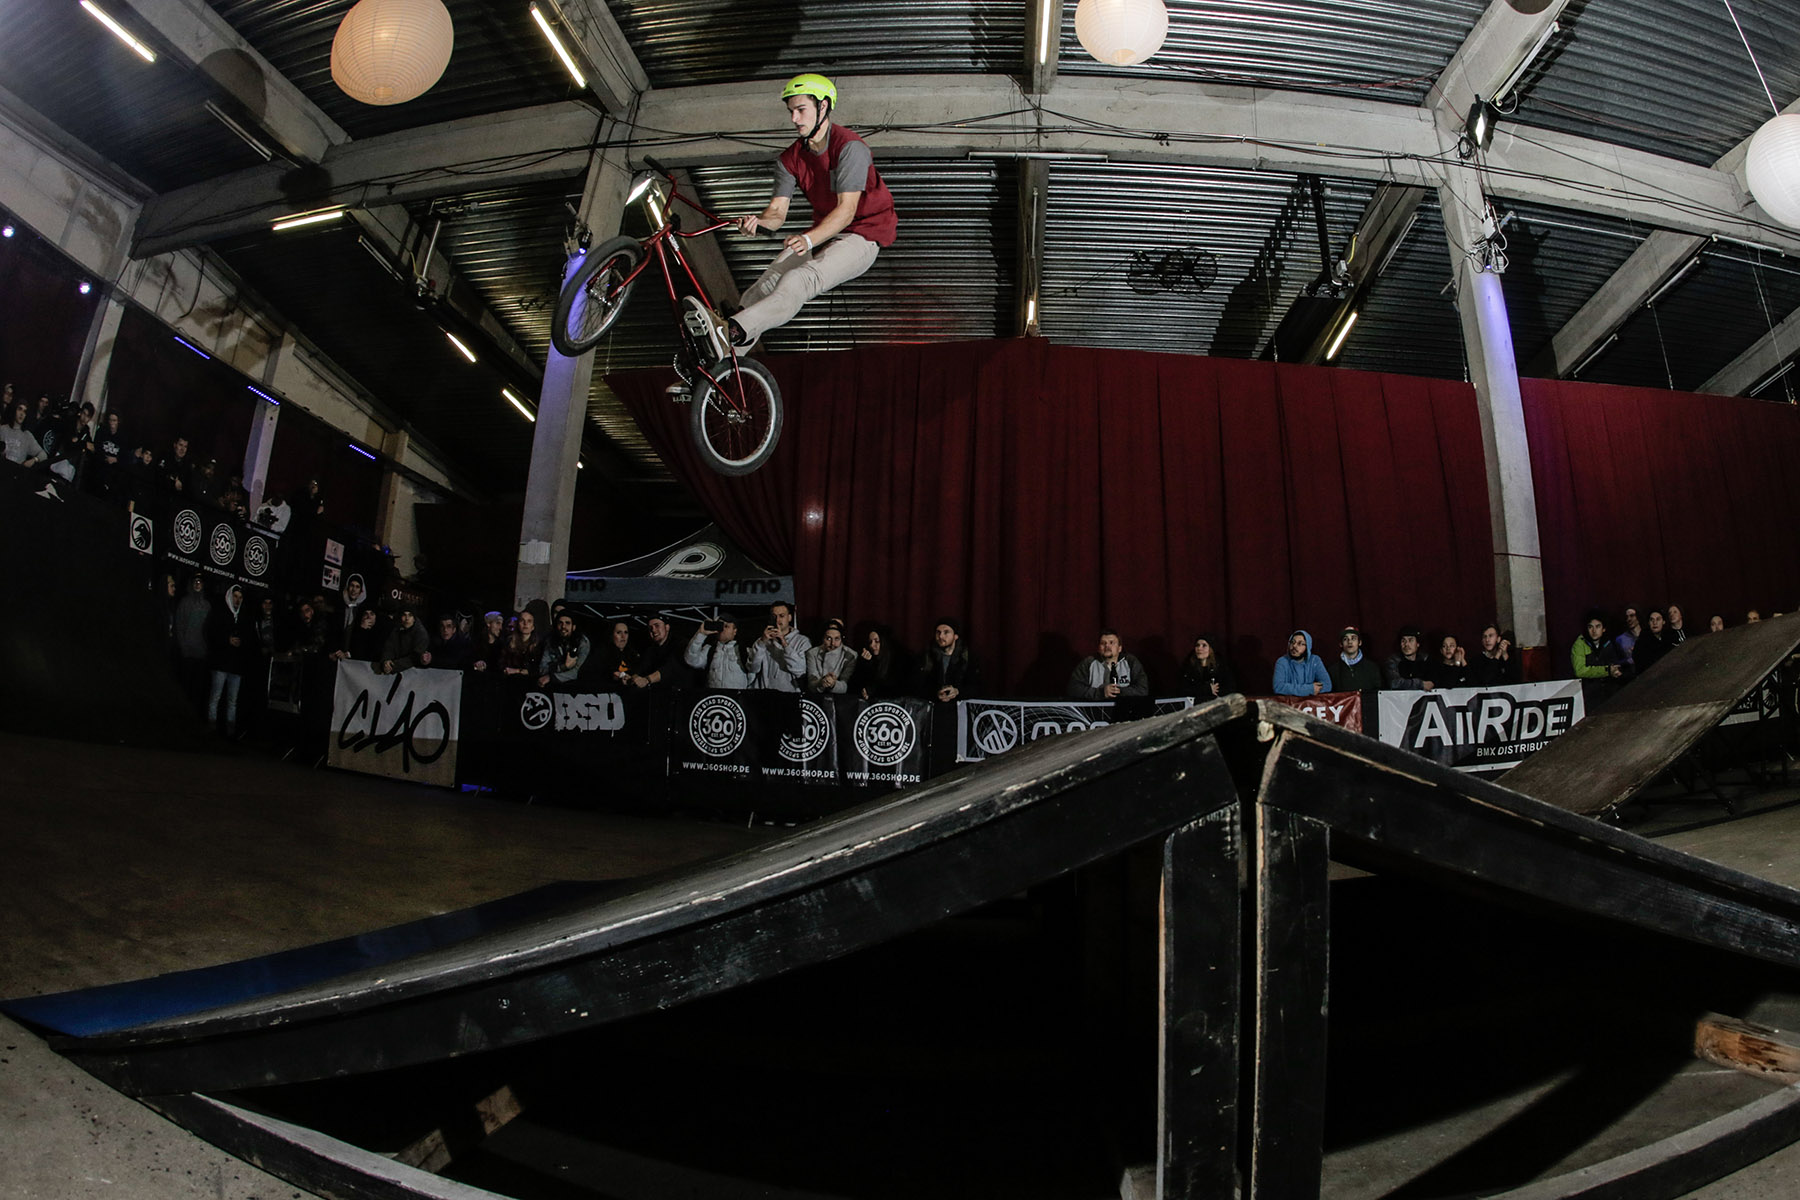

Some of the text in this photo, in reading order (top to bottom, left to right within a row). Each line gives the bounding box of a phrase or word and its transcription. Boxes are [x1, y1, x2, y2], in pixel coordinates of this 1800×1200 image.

[180, 521, 196, 540] 360
[215, 537, 231, 552] 360
[249, 549, 263, 564] 360
[566, 578, 606, 592] rimo
[715, 579, 781, 598] primo
[553, 692, 626, 737] BSD
[702, 715, 735, 736] 360
[868, 723, 903, 744] 360
[1476, 741, 1549, 757] BMX DISTRIBUT
[682, 761, 750, 774] WWW.360SHOP.DE
[761, 766, 835, 779] WWW.360SHOP.DE
[846, 771, 921, 783] WWW.360SHOP.DE
